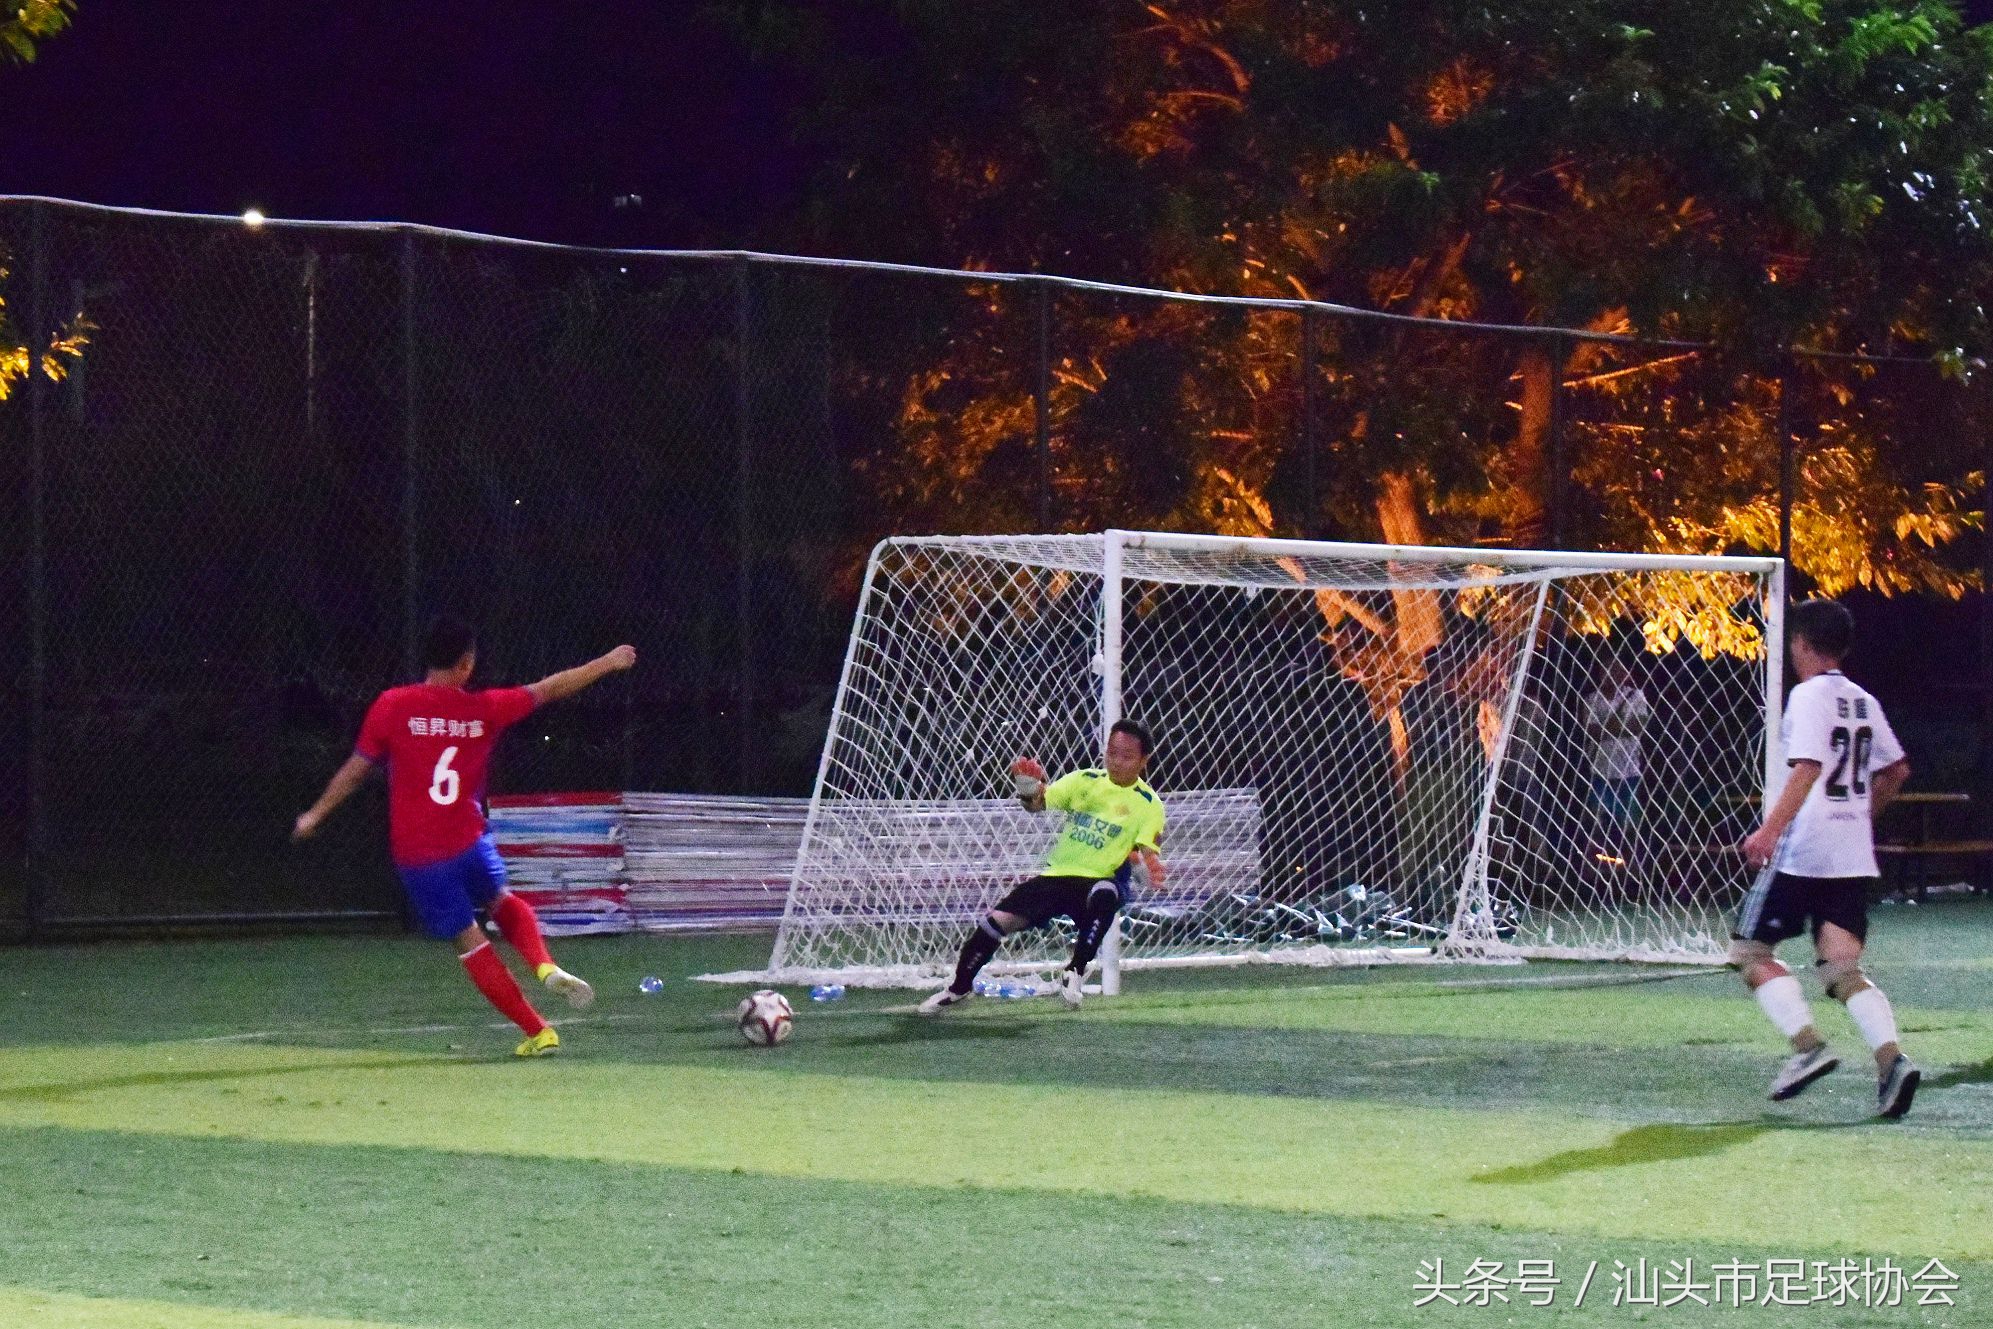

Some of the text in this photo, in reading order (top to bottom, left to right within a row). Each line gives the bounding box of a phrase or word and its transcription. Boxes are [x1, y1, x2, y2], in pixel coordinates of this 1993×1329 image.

[428, 745, 460, 806] 6
[1825, 725, 1872, 801] 20
[1069, 825, 1105, 849] 2006
